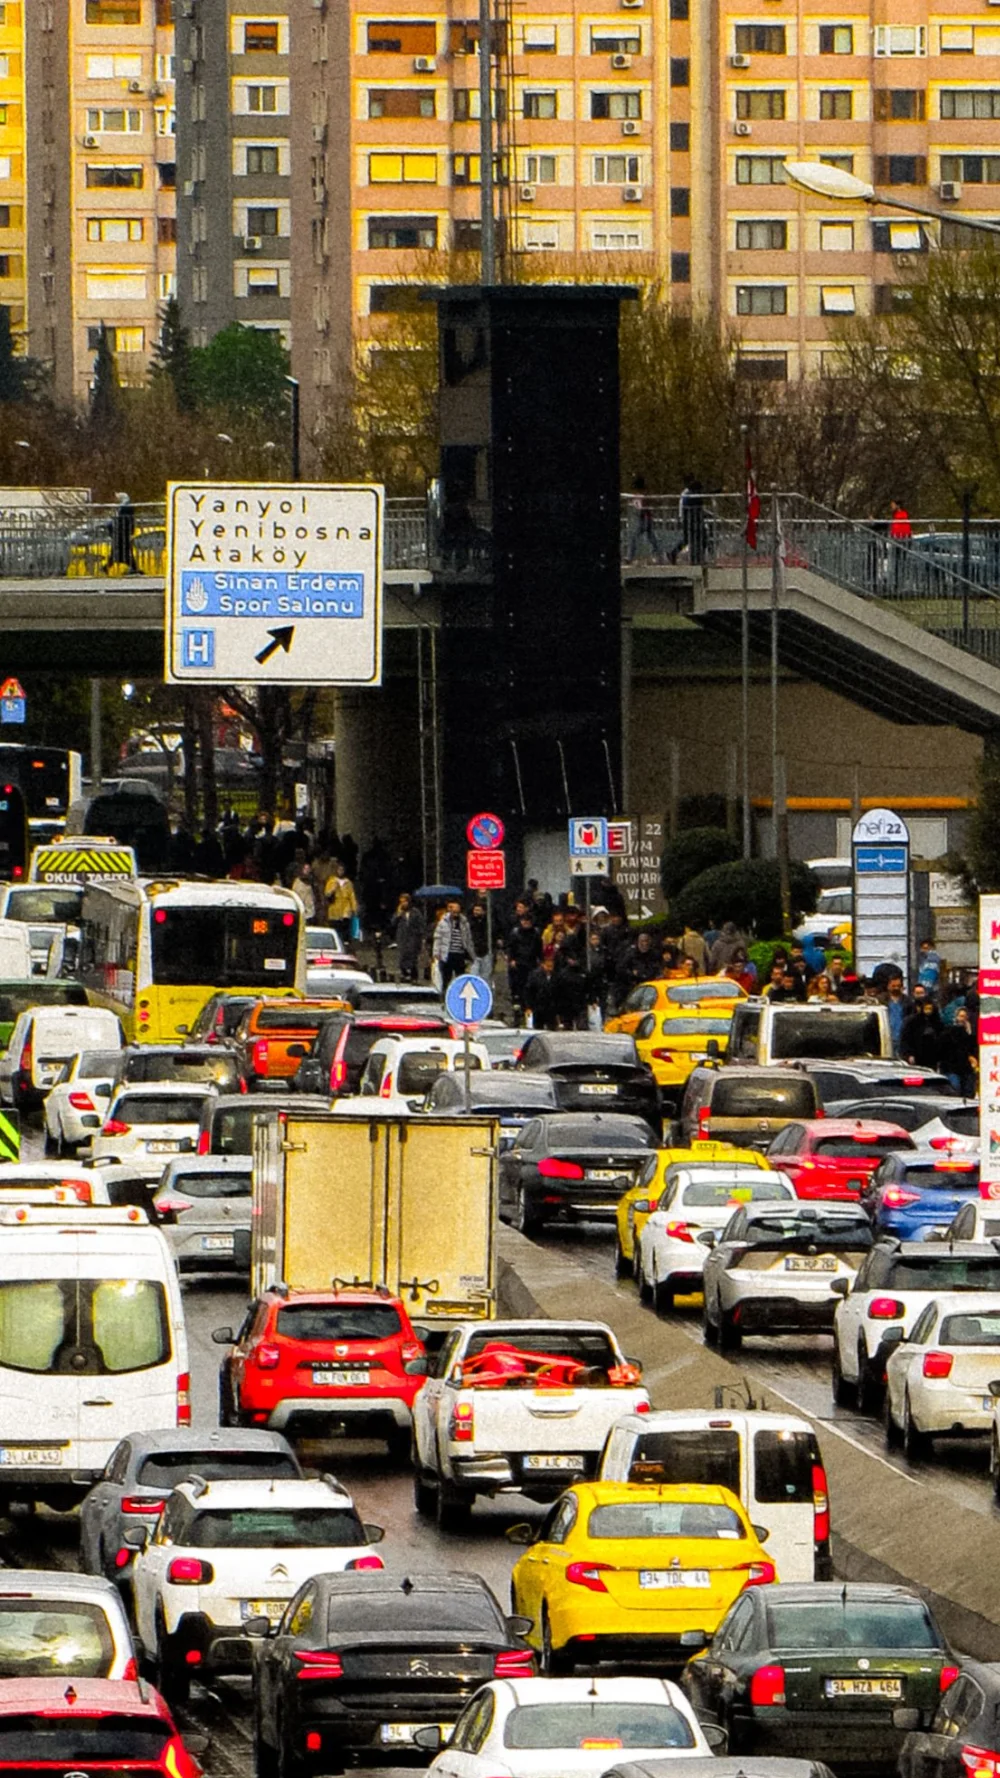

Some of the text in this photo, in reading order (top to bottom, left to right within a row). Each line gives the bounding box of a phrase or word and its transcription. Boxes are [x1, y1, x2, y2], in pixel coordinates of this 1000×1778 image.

[189, 493, 307, 518] Yanyol
[189, 519, 373, 541] Yenibosna
[189, 543, 308, 568] Ataköy
[214, 573, 360, 592] Sinan Erdem
[219, 595, 355, 616] Spor Salonu
[188, 632, 209, 663] H
[647, 1571, 659, 1583] 34
[248, 1602, 261, 1614] 34
[833, 1680, 846, 1693] 34
[390, 1724, 402, 1738] 34
